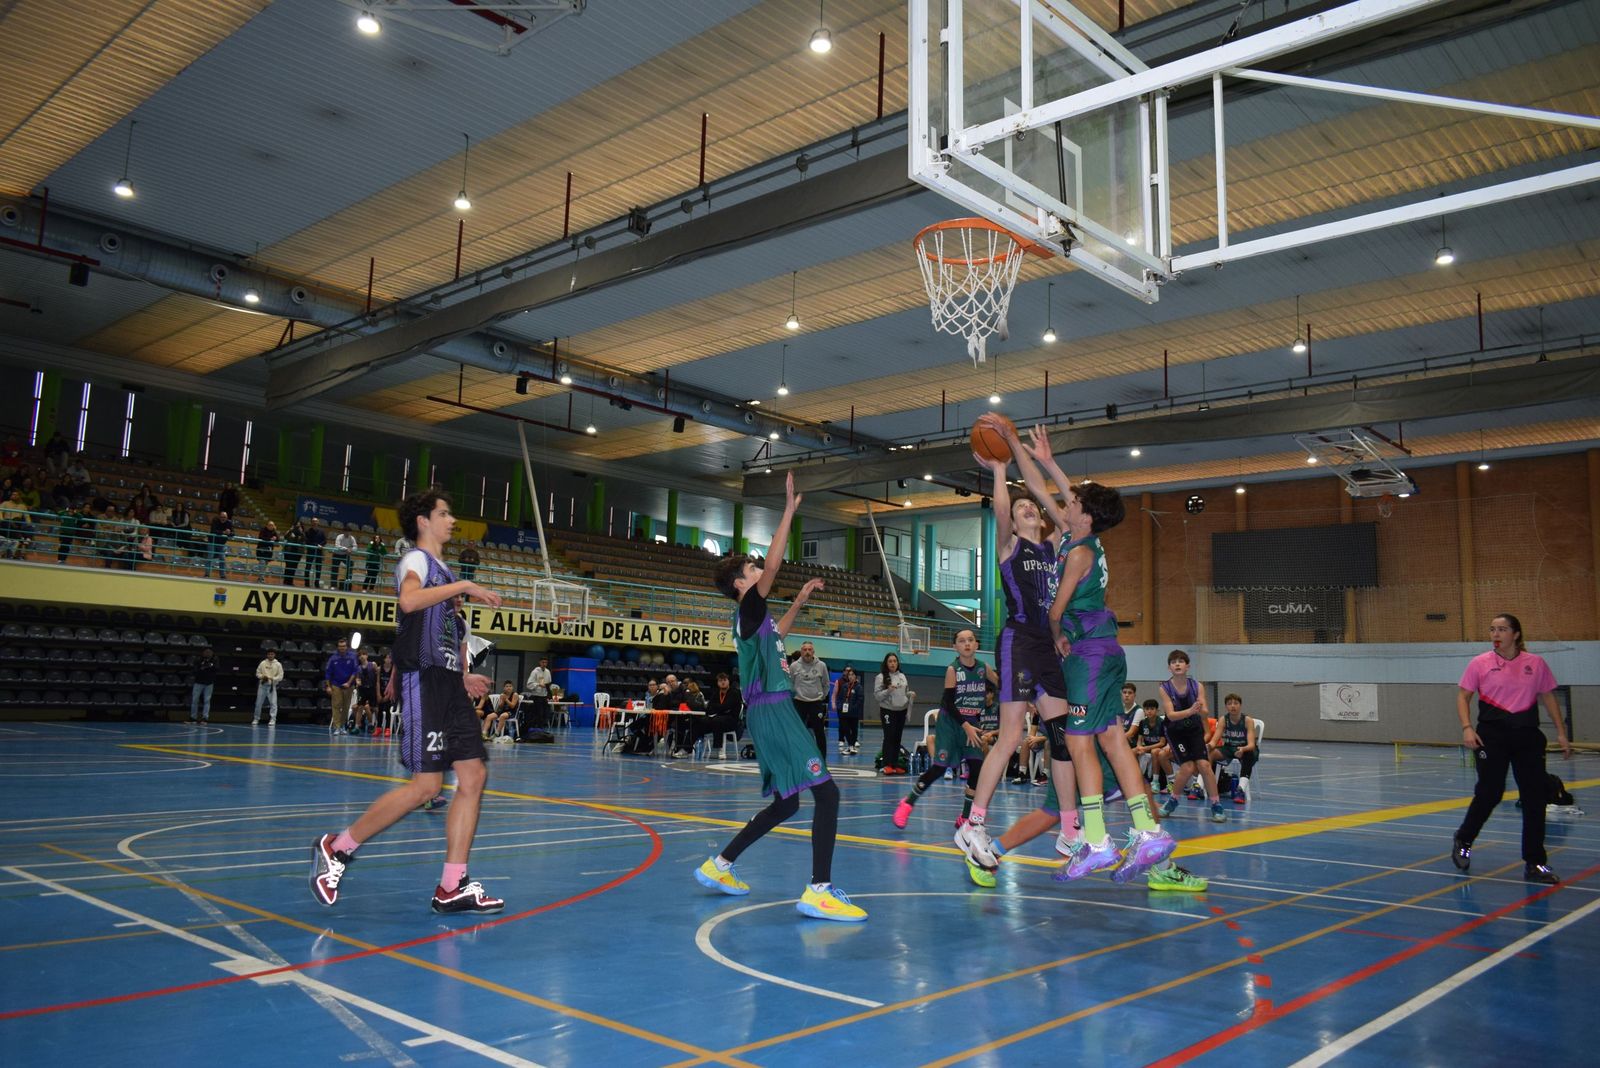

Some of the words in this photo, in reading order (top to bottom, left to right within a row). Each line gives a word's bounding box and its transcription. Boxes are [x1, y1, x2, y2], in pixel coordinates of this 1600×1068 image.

[242, 590, 399, 623] AYUNTAMIE
[602, 621, 624, 640] DE
[630, 624, 652, 642] LA
[658, 626, 710, 647] TORRE
[1178, 743, 1186, 753] 8
